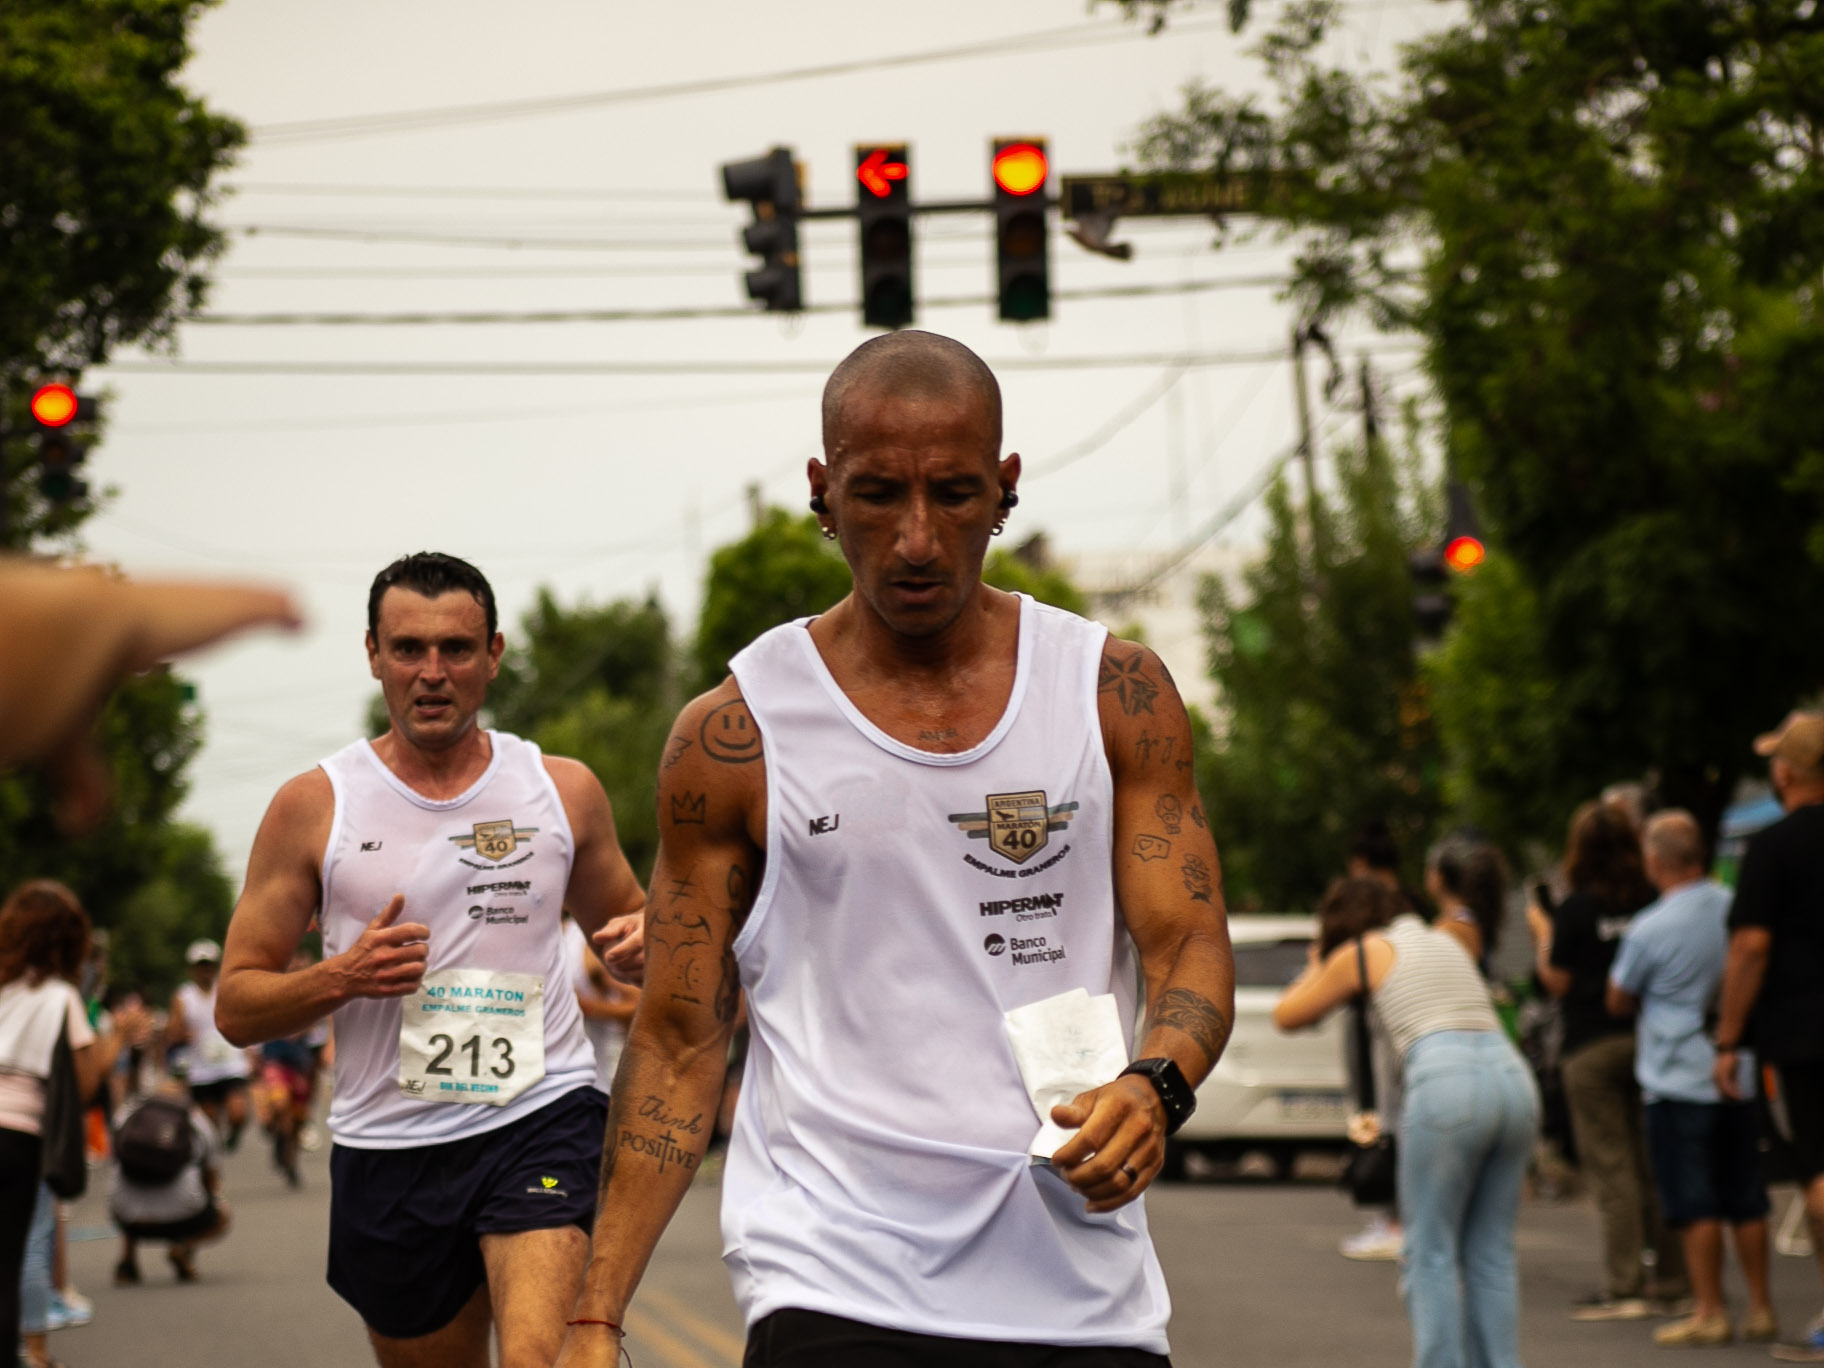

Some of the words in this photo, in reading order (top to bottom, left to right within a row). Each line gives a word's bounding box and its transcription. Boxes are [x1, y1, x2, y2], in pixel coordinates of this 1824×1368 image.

[994, 798, 1040, 808] ARGENTINA
[809, 813, 840, 837] NEJ
[360, 841, 383, 852] NEJ
[485, 840, 508, 853] 40
[1002, 829, 1037, 850] 40
[963, 853, 1017, 878] EMPALME
[1018, 844, 1071, 878] GRANEROS
[486, 906, 515, 916] Banco
[486, 914, 529, 925] Municipal
[1010, 937, 1046, 951] Banco
[1011, 945, 1066, 966] Municipal
[427, 987, 446, 998] 40
[450, 987, 525, 1002] MARATON
[422, 1003, 472, 1013] EMPALME
[475, 1005, 526, 1017] GRANEROS
[425, 1033, 516, 1079] 213
[638, 1095, 703, 1134] Think
[620, 1130, 697, 1174] POSITIVE
